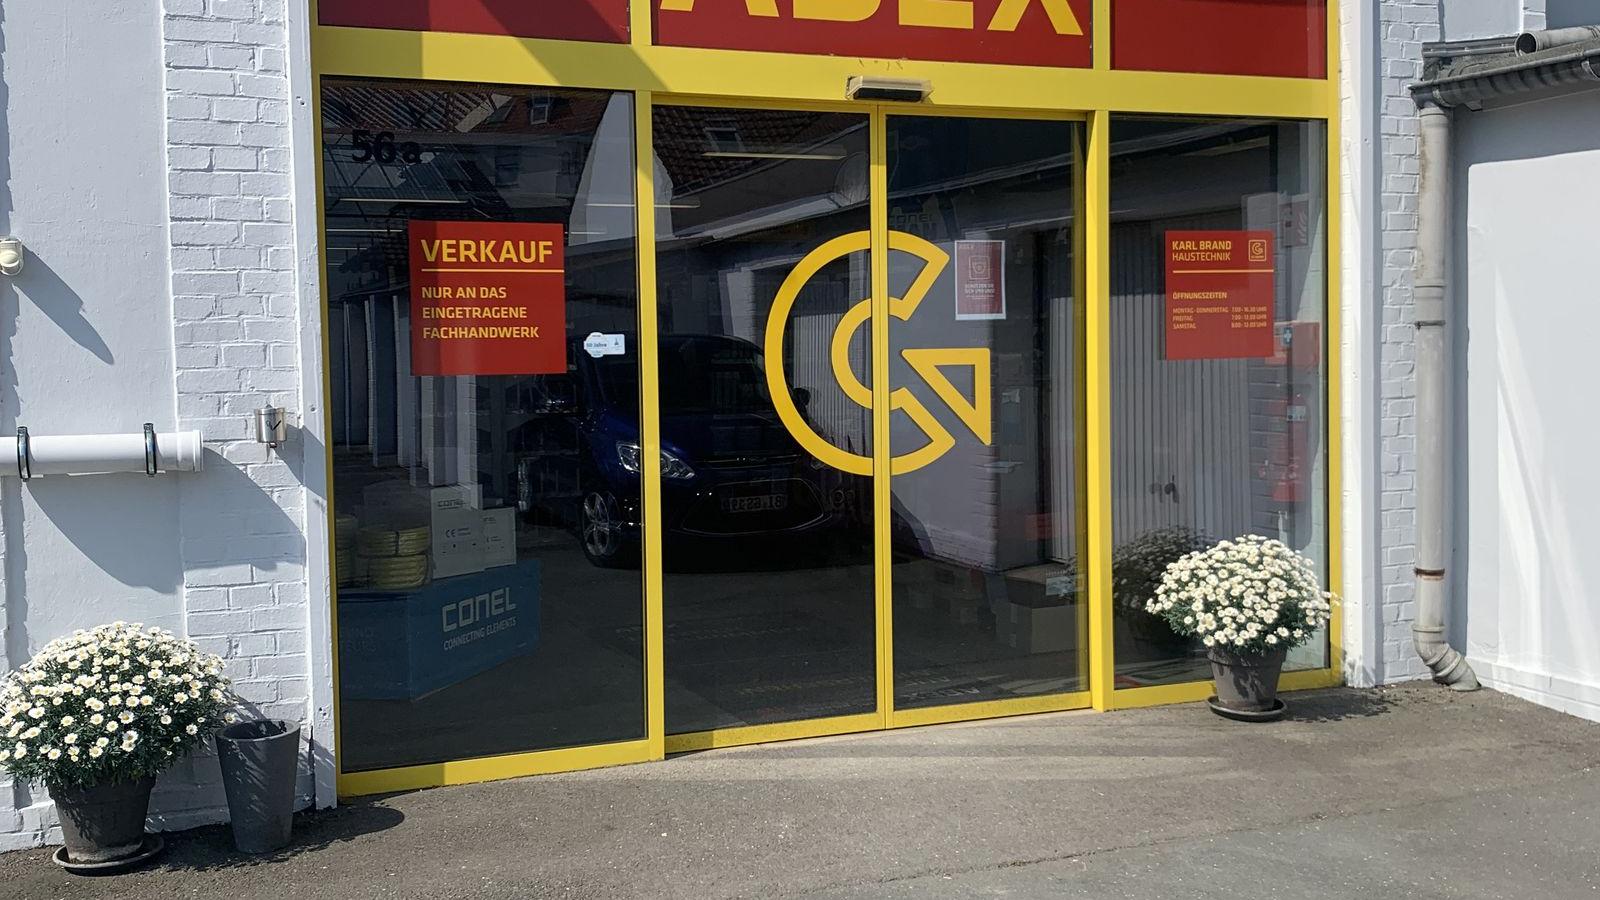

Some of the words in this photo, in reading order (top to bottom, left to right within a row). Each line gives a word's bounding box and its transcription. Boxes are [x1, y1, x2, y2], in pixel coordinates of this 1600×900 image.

[1172, 240, 1197, 250] KARL
[1200, 240, 1231, 250] BRAND
[421, 239, 553, 263] VERKAUF
[1172, 252, 1231, 261] HAUSTECHNIK
[422, 287, 452, 298] NUR
[456, 287, 476, 298] AN
[480, 287, 507, 298] DAS
[1173, 291, 1227, 300] ÖFFNUNGSZEITEN
[422, 307, 527, 318] EINGETRAGENE
[423, 327, 539, 339] FACHHANDWERK
[442, 587, 516, 632] CONEL
[443, 629, 485, 651] CONNECTING
[486, 616, 516, 636] ELEMENTS
